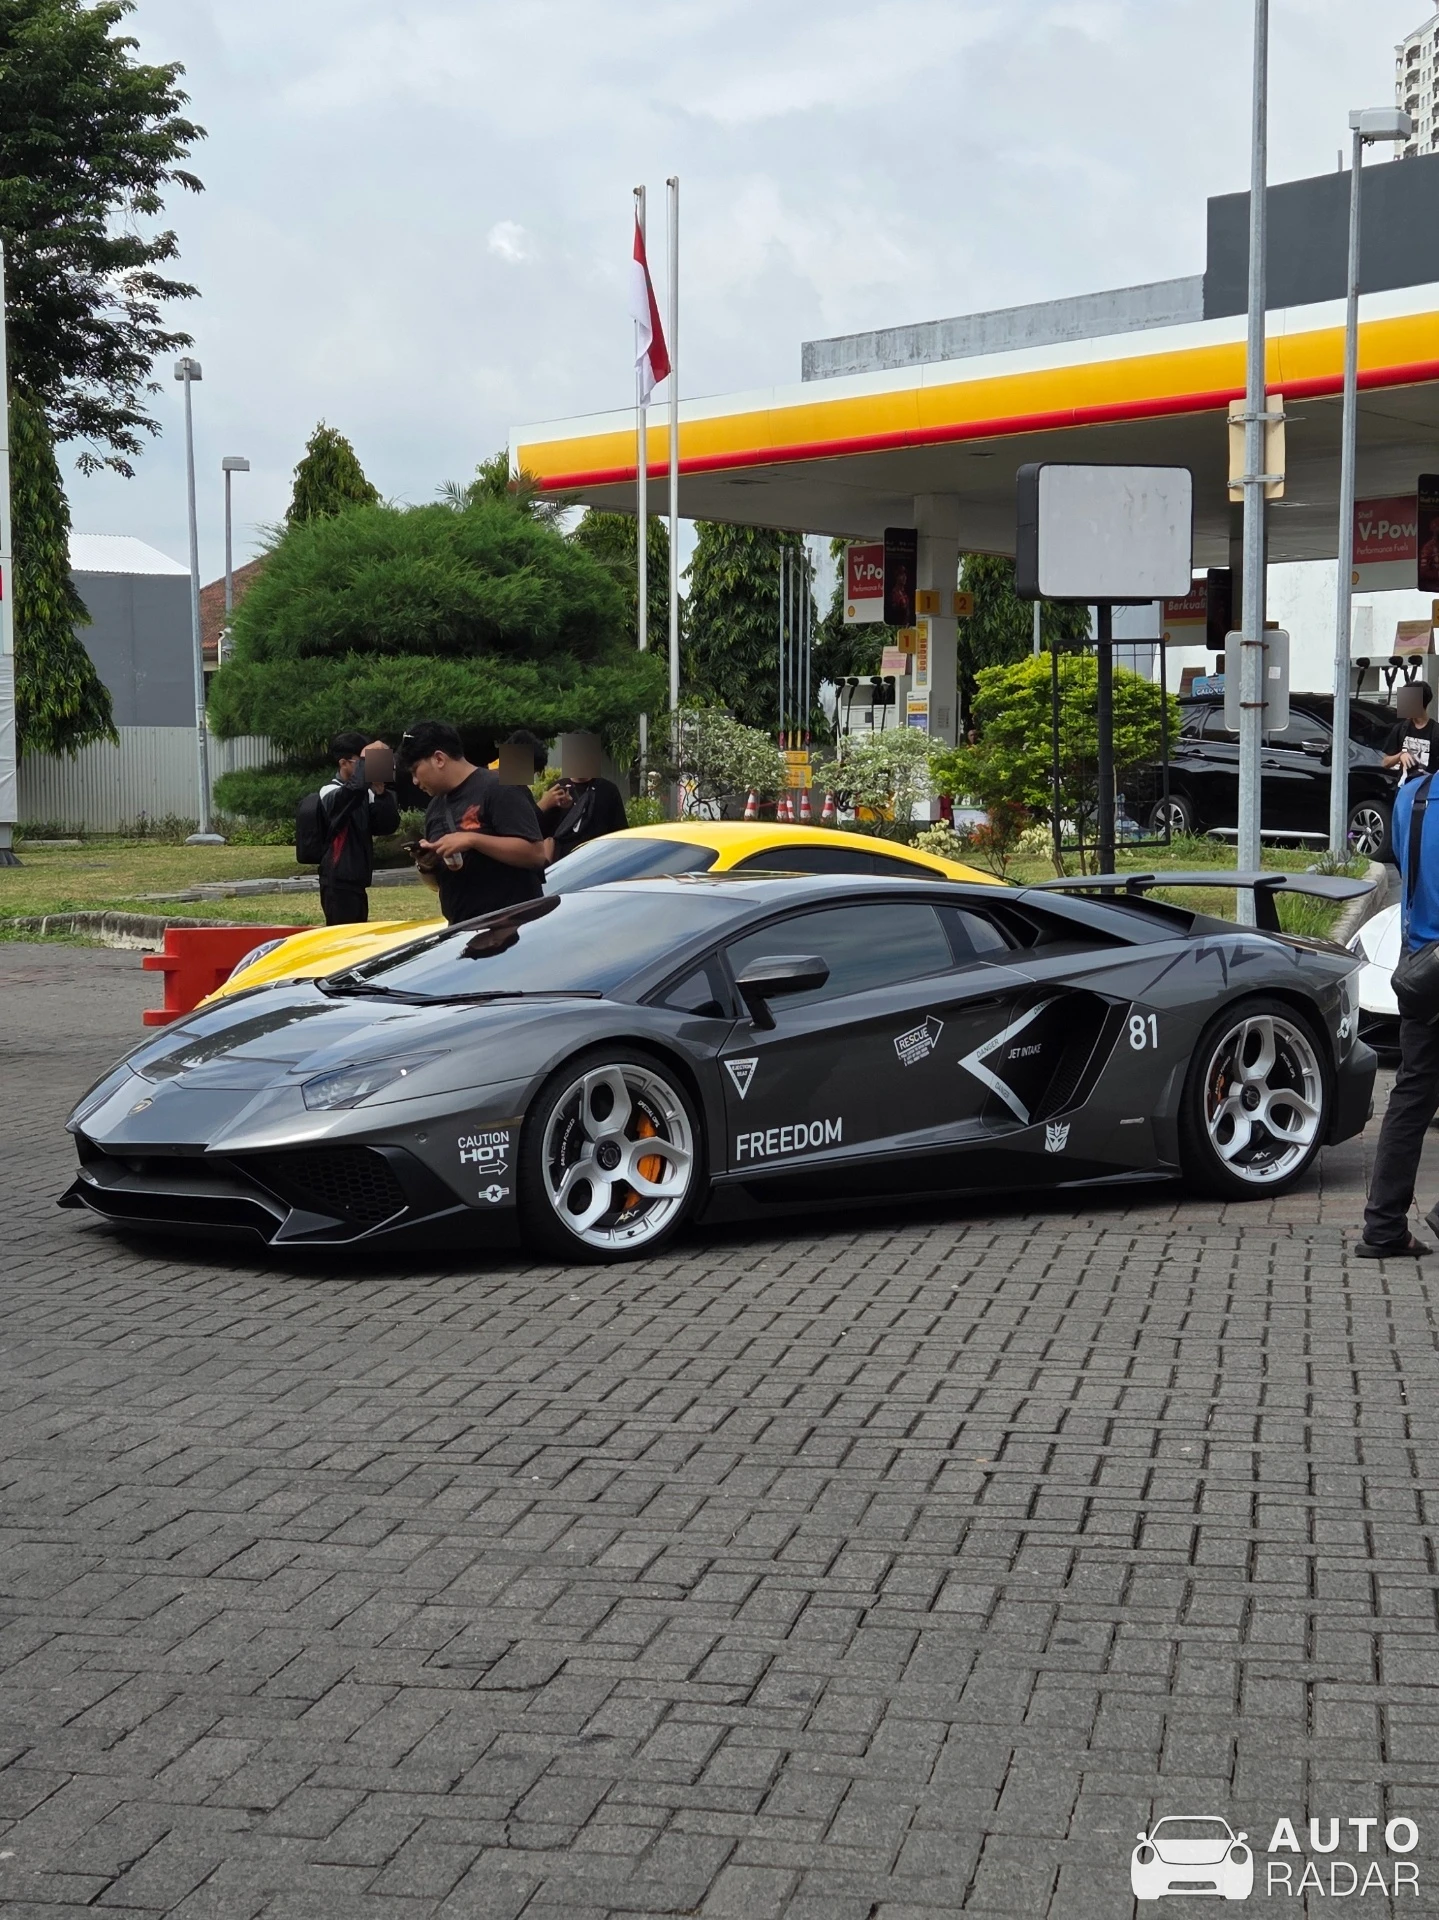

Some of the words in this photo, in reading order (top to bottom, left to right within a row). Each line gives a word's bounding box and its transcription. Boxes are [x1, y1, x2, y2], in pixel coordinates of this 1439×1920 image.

[1358, 520, 1417, 541] V-Pow
[1356, 546, 1393, 555] Performance
[1393, 542, 1409, 552] Fuels
[926, 596, 931, 609] 1
[959, 597, 967, 610] 2
[903, 635, 910, 648] 1
[899, 1026, 929, 1050] RESCUE
[1129, 1013, 1158, 1050] 81
[976, 1038, 1000, 1059] DANGER
[1007, 1047, 1021, 1059] JET
[1020, 1043, 1042, 1057] INTAKE
[457, 1130, 510, 1148] CAUTION
[736, 1116, 842, 1161] FREEDOM
[459, 1143, 510, 1164] HOT
